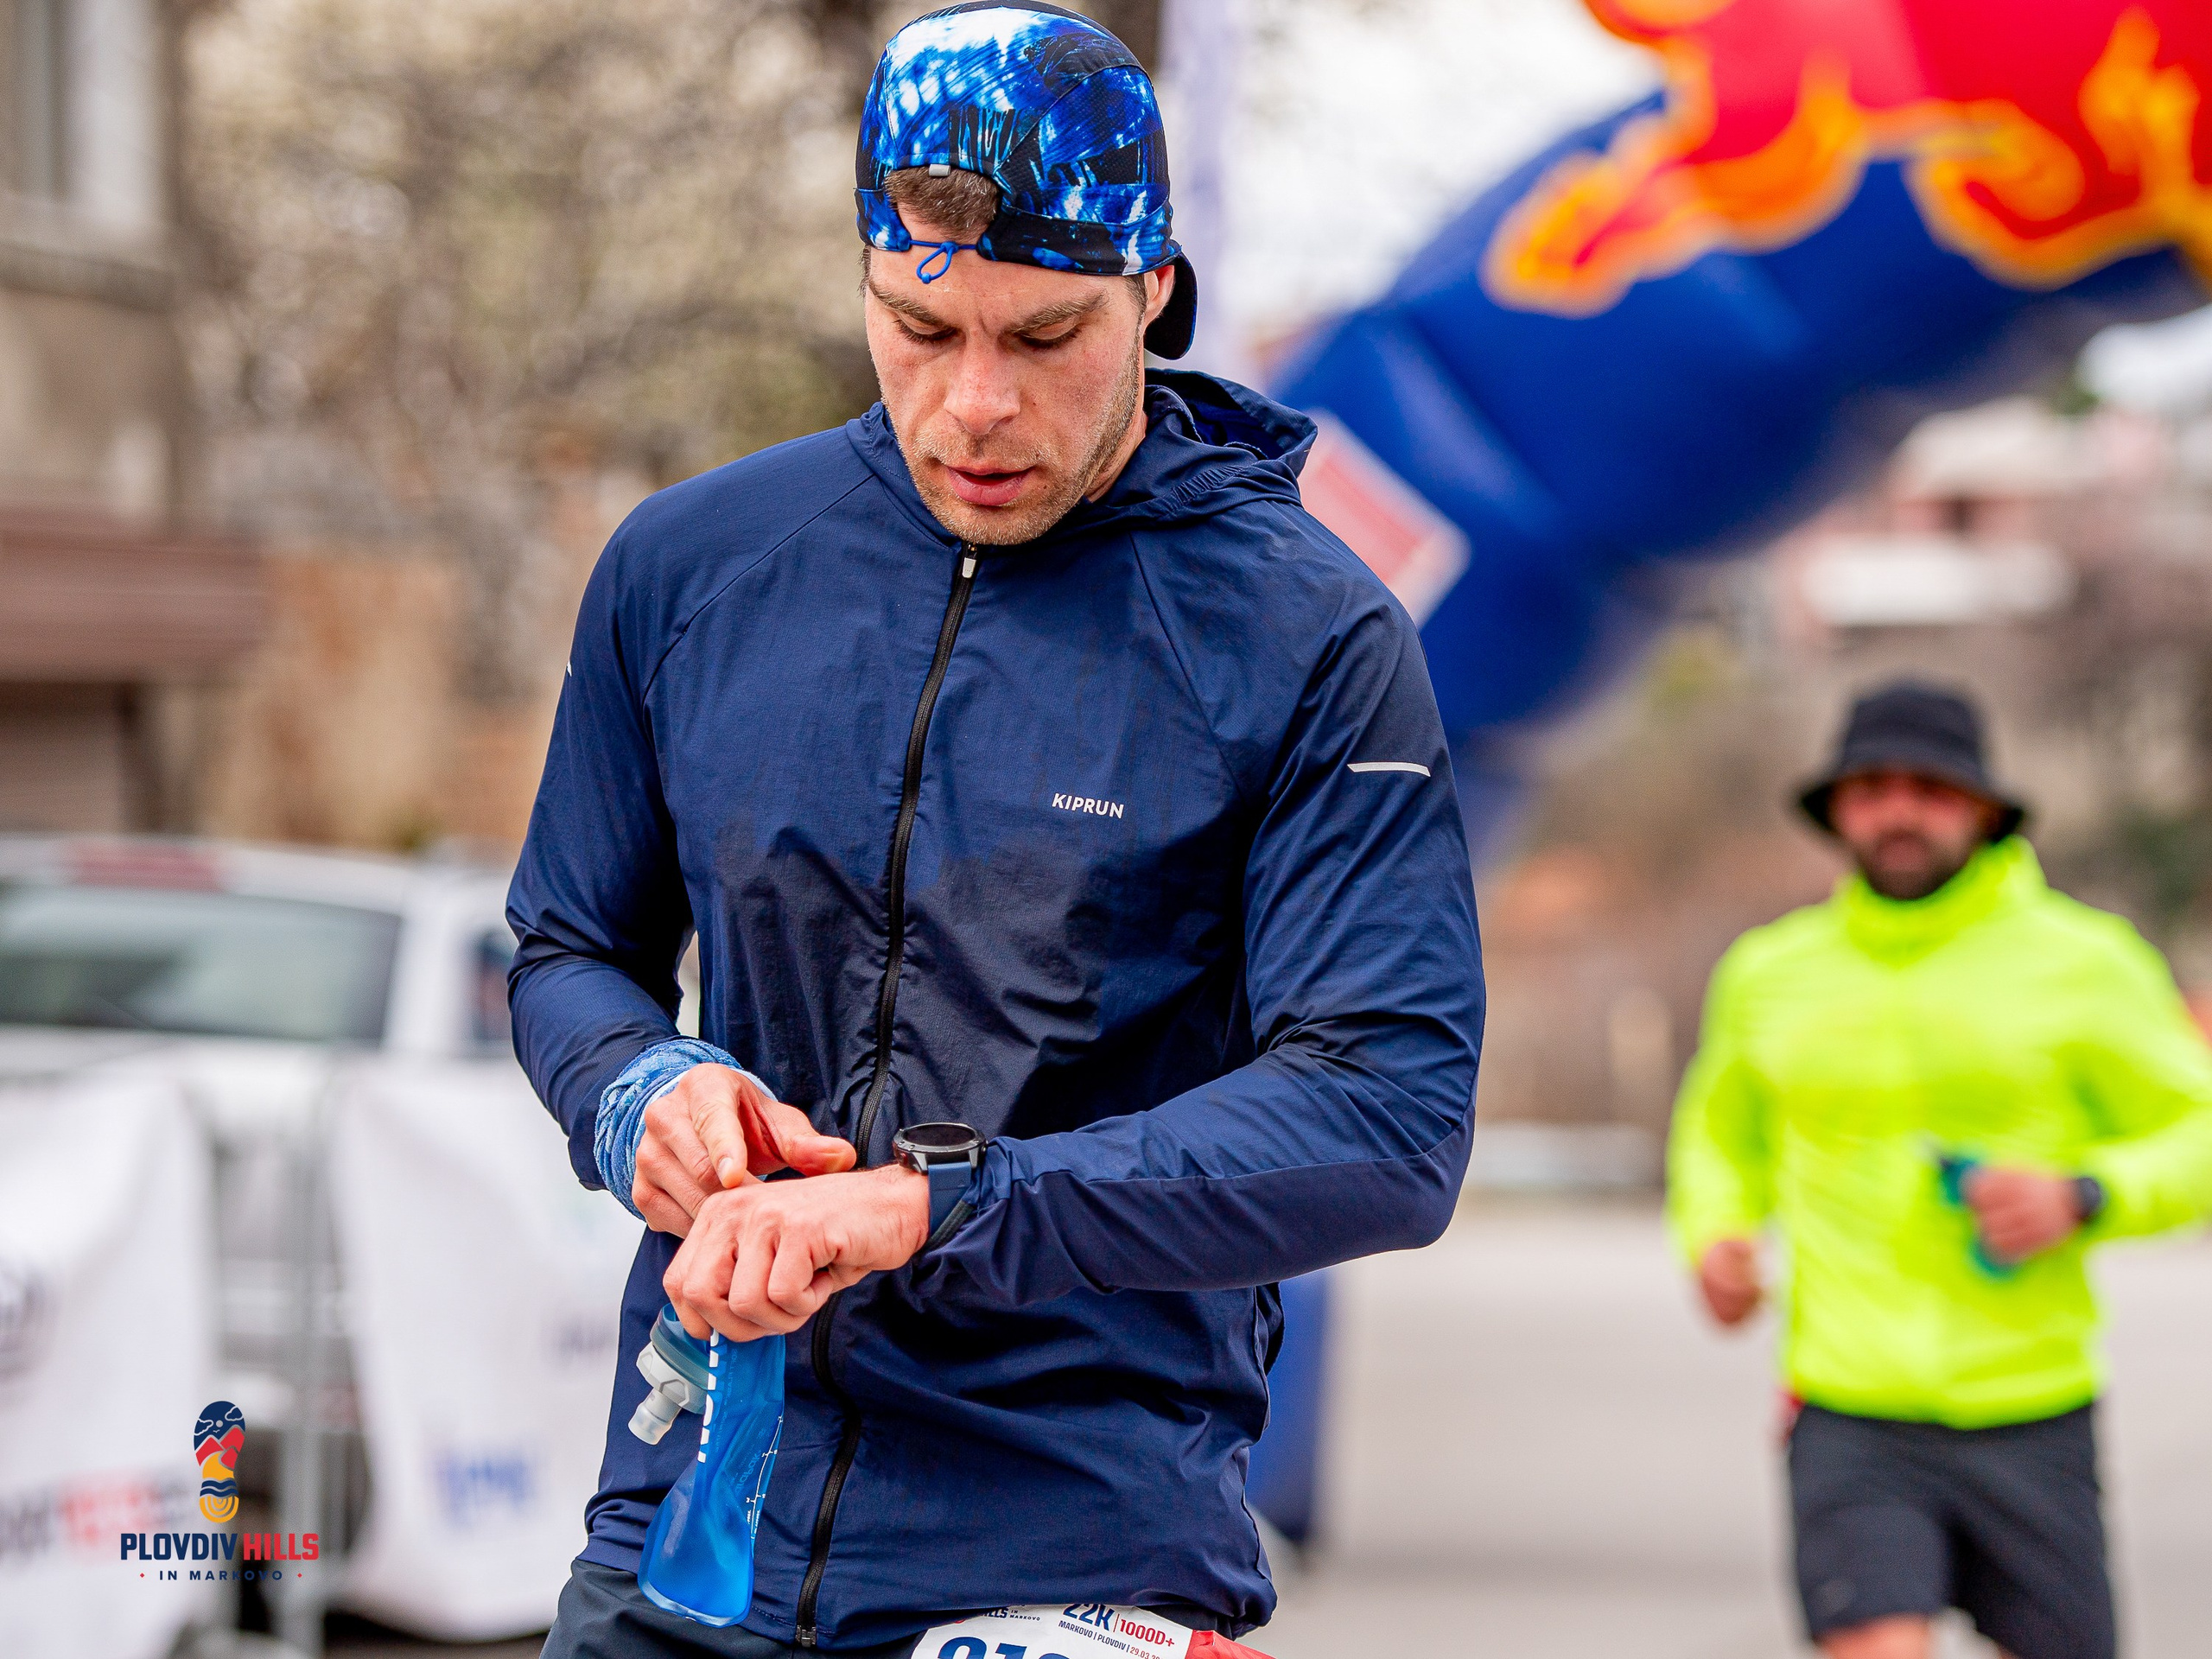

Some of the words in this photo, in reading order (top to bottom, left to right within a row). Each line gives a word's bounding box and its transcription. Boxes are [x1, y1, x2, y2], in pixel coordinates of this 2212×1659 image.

[1052, 793, 1124, 819] KIPRUN
[1058, 1620, 1093, 1638] MARKOVO
[1097, 1634, 1127, 1650] PLOVDIV
[1063, 1604, 1115, 1630] 22K
[1120, 1618, 1175, 1647] 1000D+
